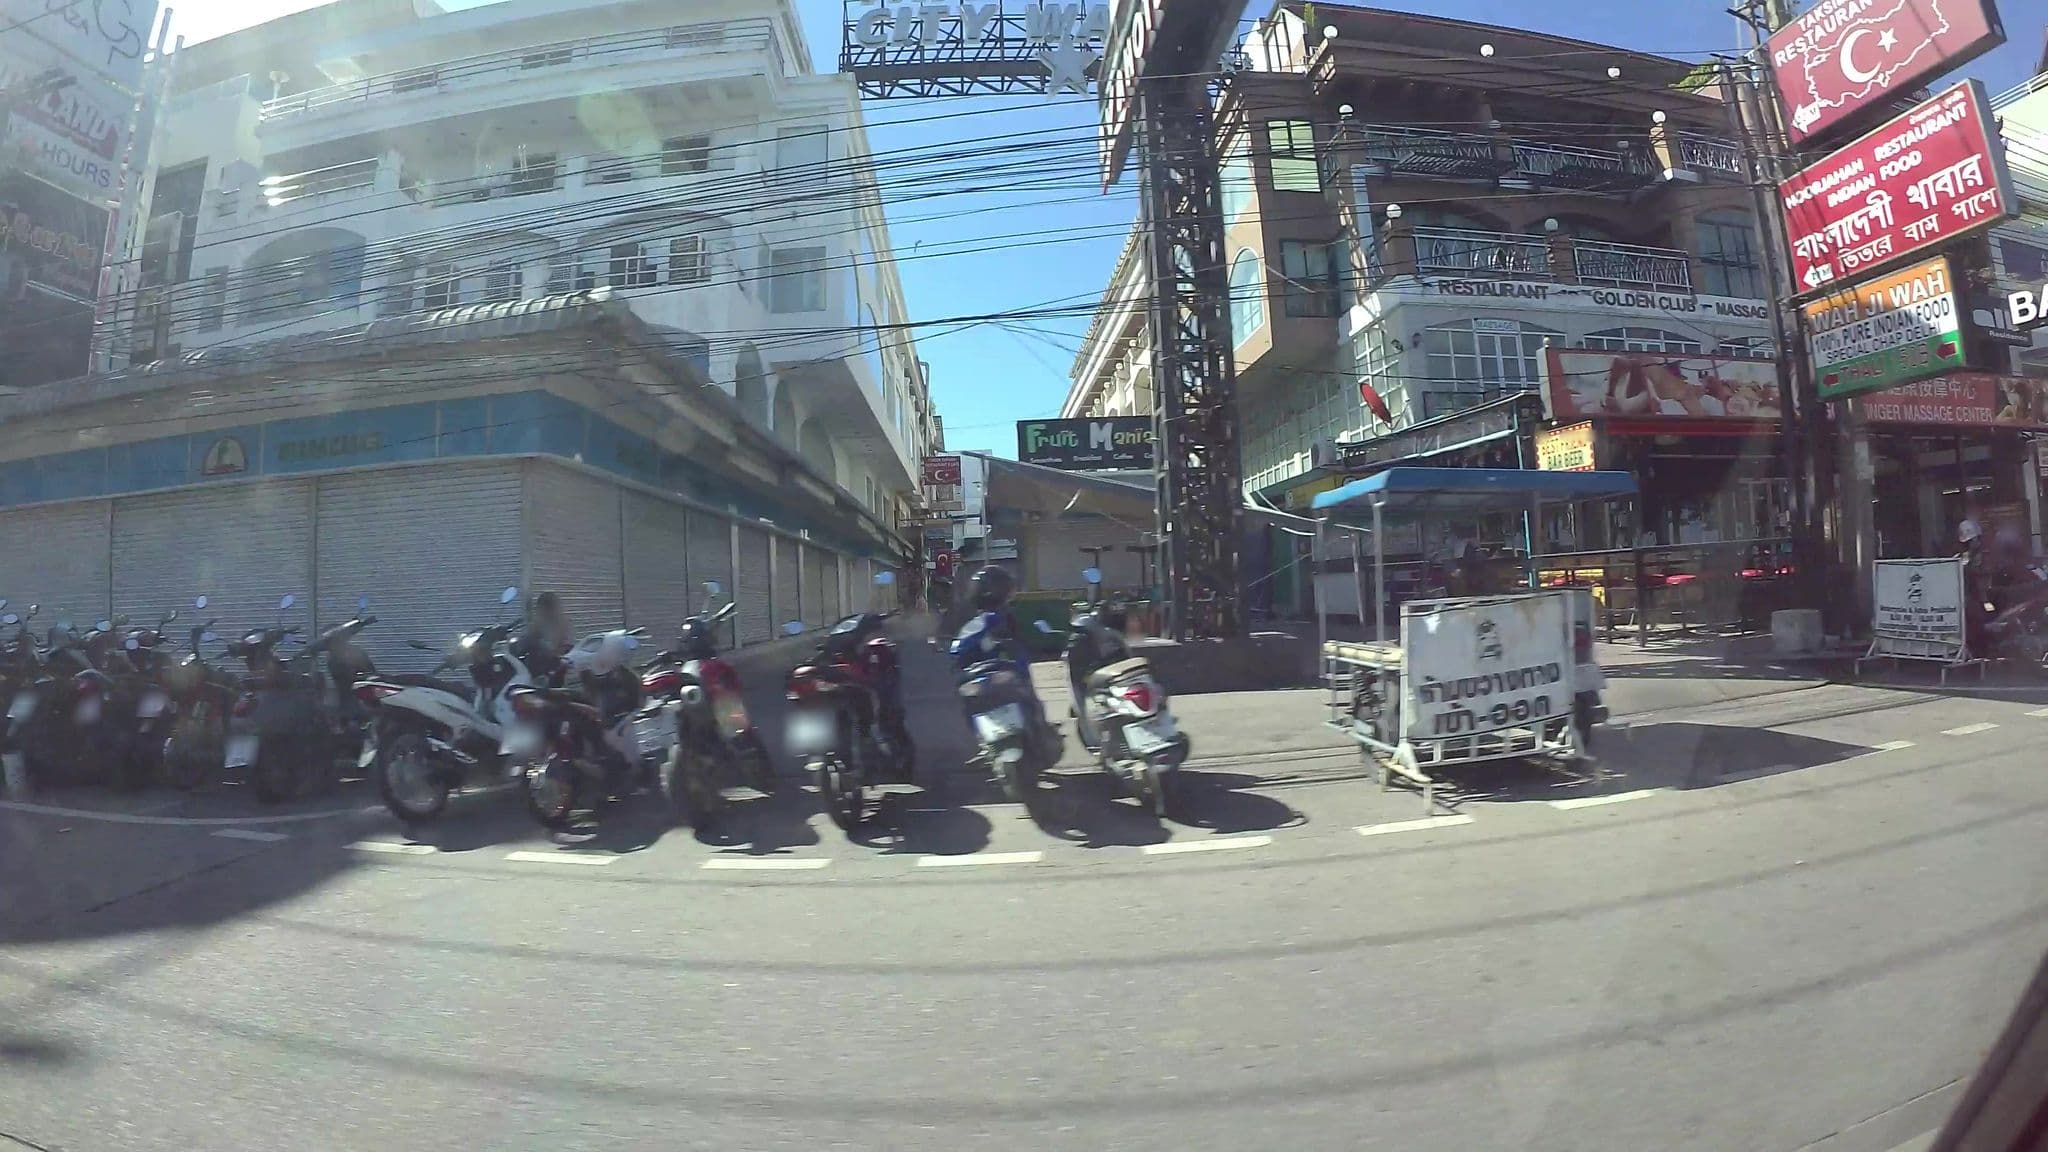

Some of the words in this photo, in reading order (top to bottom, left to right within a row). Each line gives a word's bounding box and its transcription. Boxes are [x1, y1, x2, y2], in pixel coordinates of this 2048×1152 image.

[855, 4, 1000, 48] CITY
[1873, 102, 1967, 161] RESTAURANT
[42, 140, 110, 187] HOURS
[1828, 174, 1876, 208] INDIAN
[1879, 151, 1922, 181] FOOD
[1438, 279, 1548, 300] RESTAURANT
[1593, 290, 1655, 309] GOLDEN
[1658, 293, 1696, 312] CLUB
[1716, 302, 1768, 319] MASSAG
[1812, 300, 1859, 334] WAH
[1867, 291, 1884, 317] JI
[1889, 270, 1945, 309] WAH
[1843, 320, 1872, 344] PURE
[1874, 309, 1914, 335] INDIAN
[1916, 297, 1950, 324] FOOD
[1826, 341, 1871, 363] SPECIAL
[1903, 404, 1953, 422] MASSAGE
[1956, 406, 1993, 423] CENTER
[1026, 423, 1079, 453] Fruit
[1090, 422, 1154, 451] Mania
